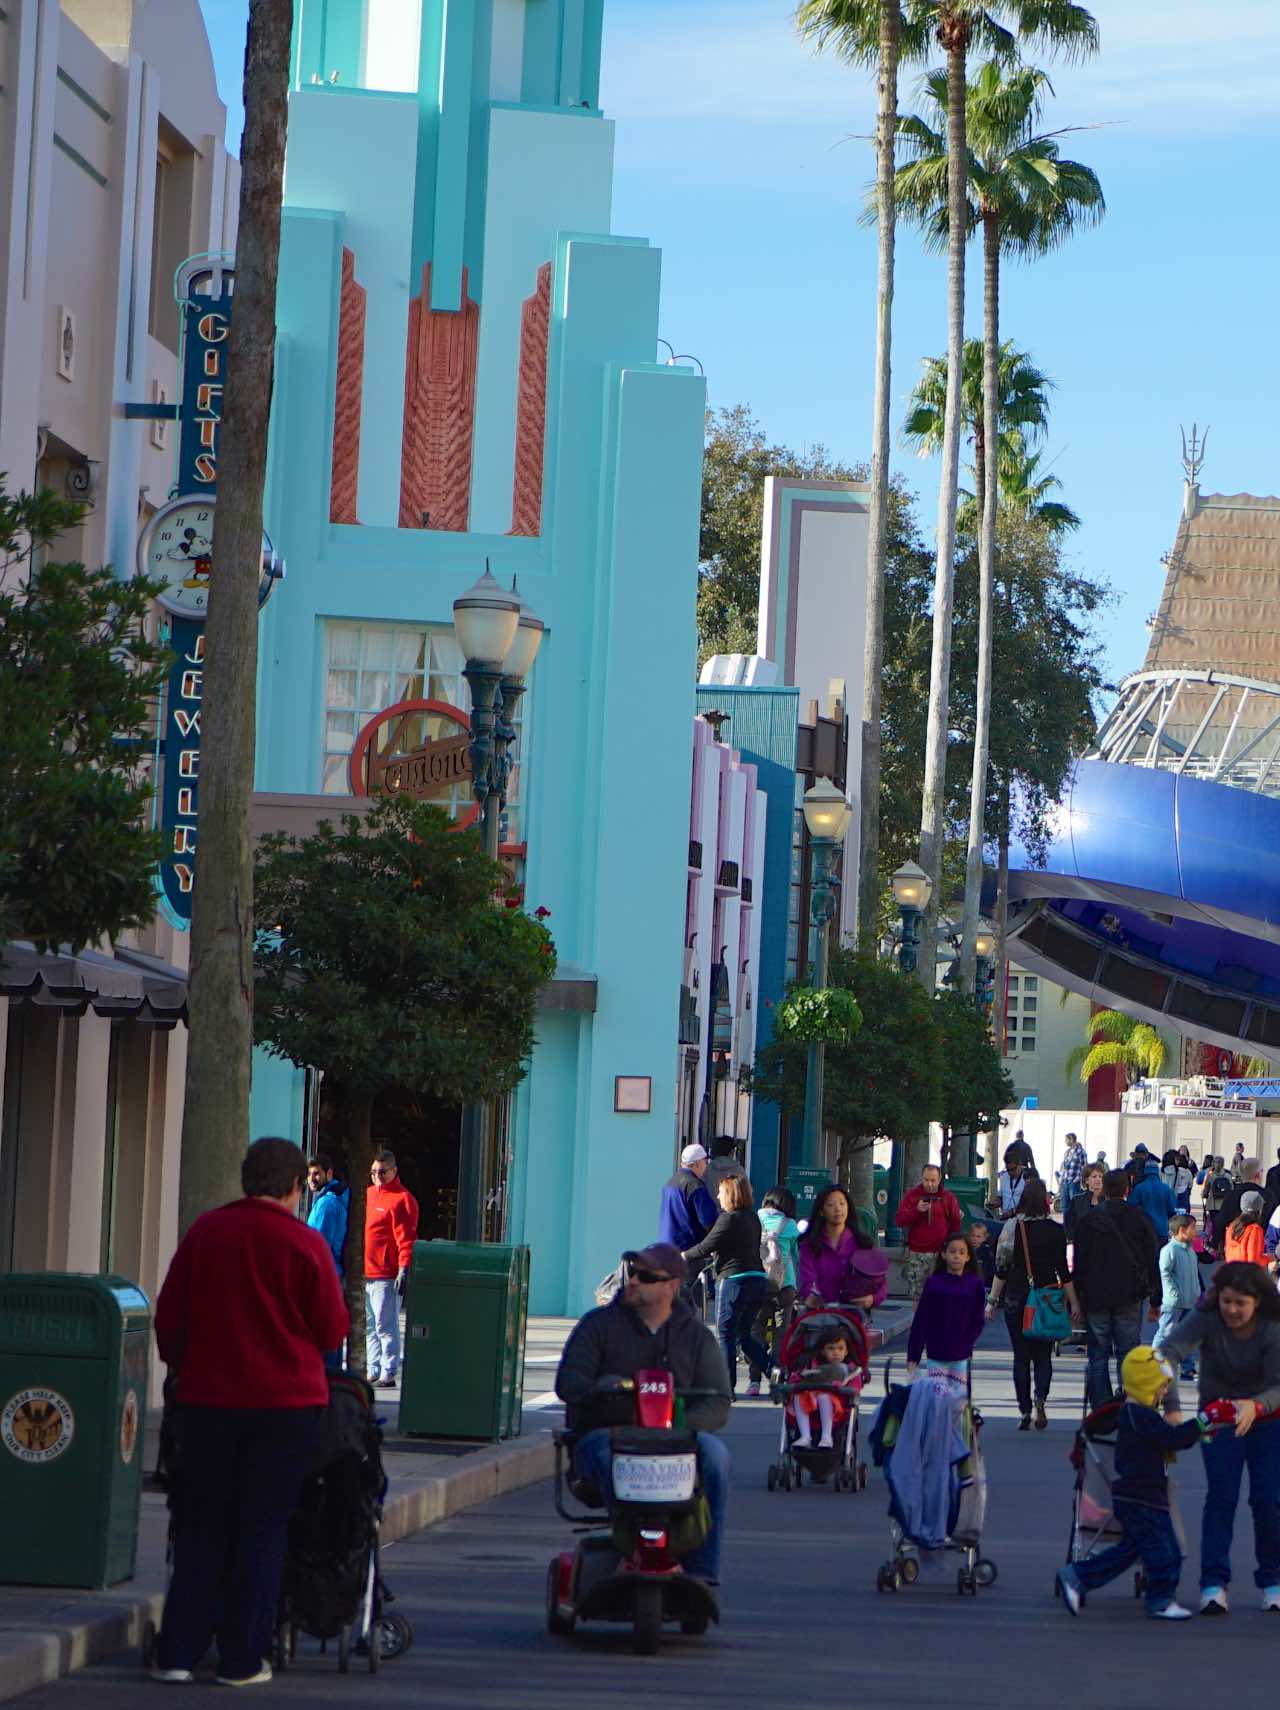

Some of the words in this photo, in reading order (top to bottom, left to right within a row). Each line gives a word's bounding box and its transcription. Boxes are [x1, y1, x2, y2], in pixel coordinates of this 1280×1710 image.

[192, 313, 229, 483] GIFTS
[197, 512, 208, 521] 12
[176, 518, 185, 527] 11
[161, 531, 172, 541] 10
[1173, 1097, 1222, 1109] COASTAL
[1224, 1100, 1253, 1111] STEEL
[640, 1382, 667, 1393] 245
[32, 1391, 55, 1399] HELP
